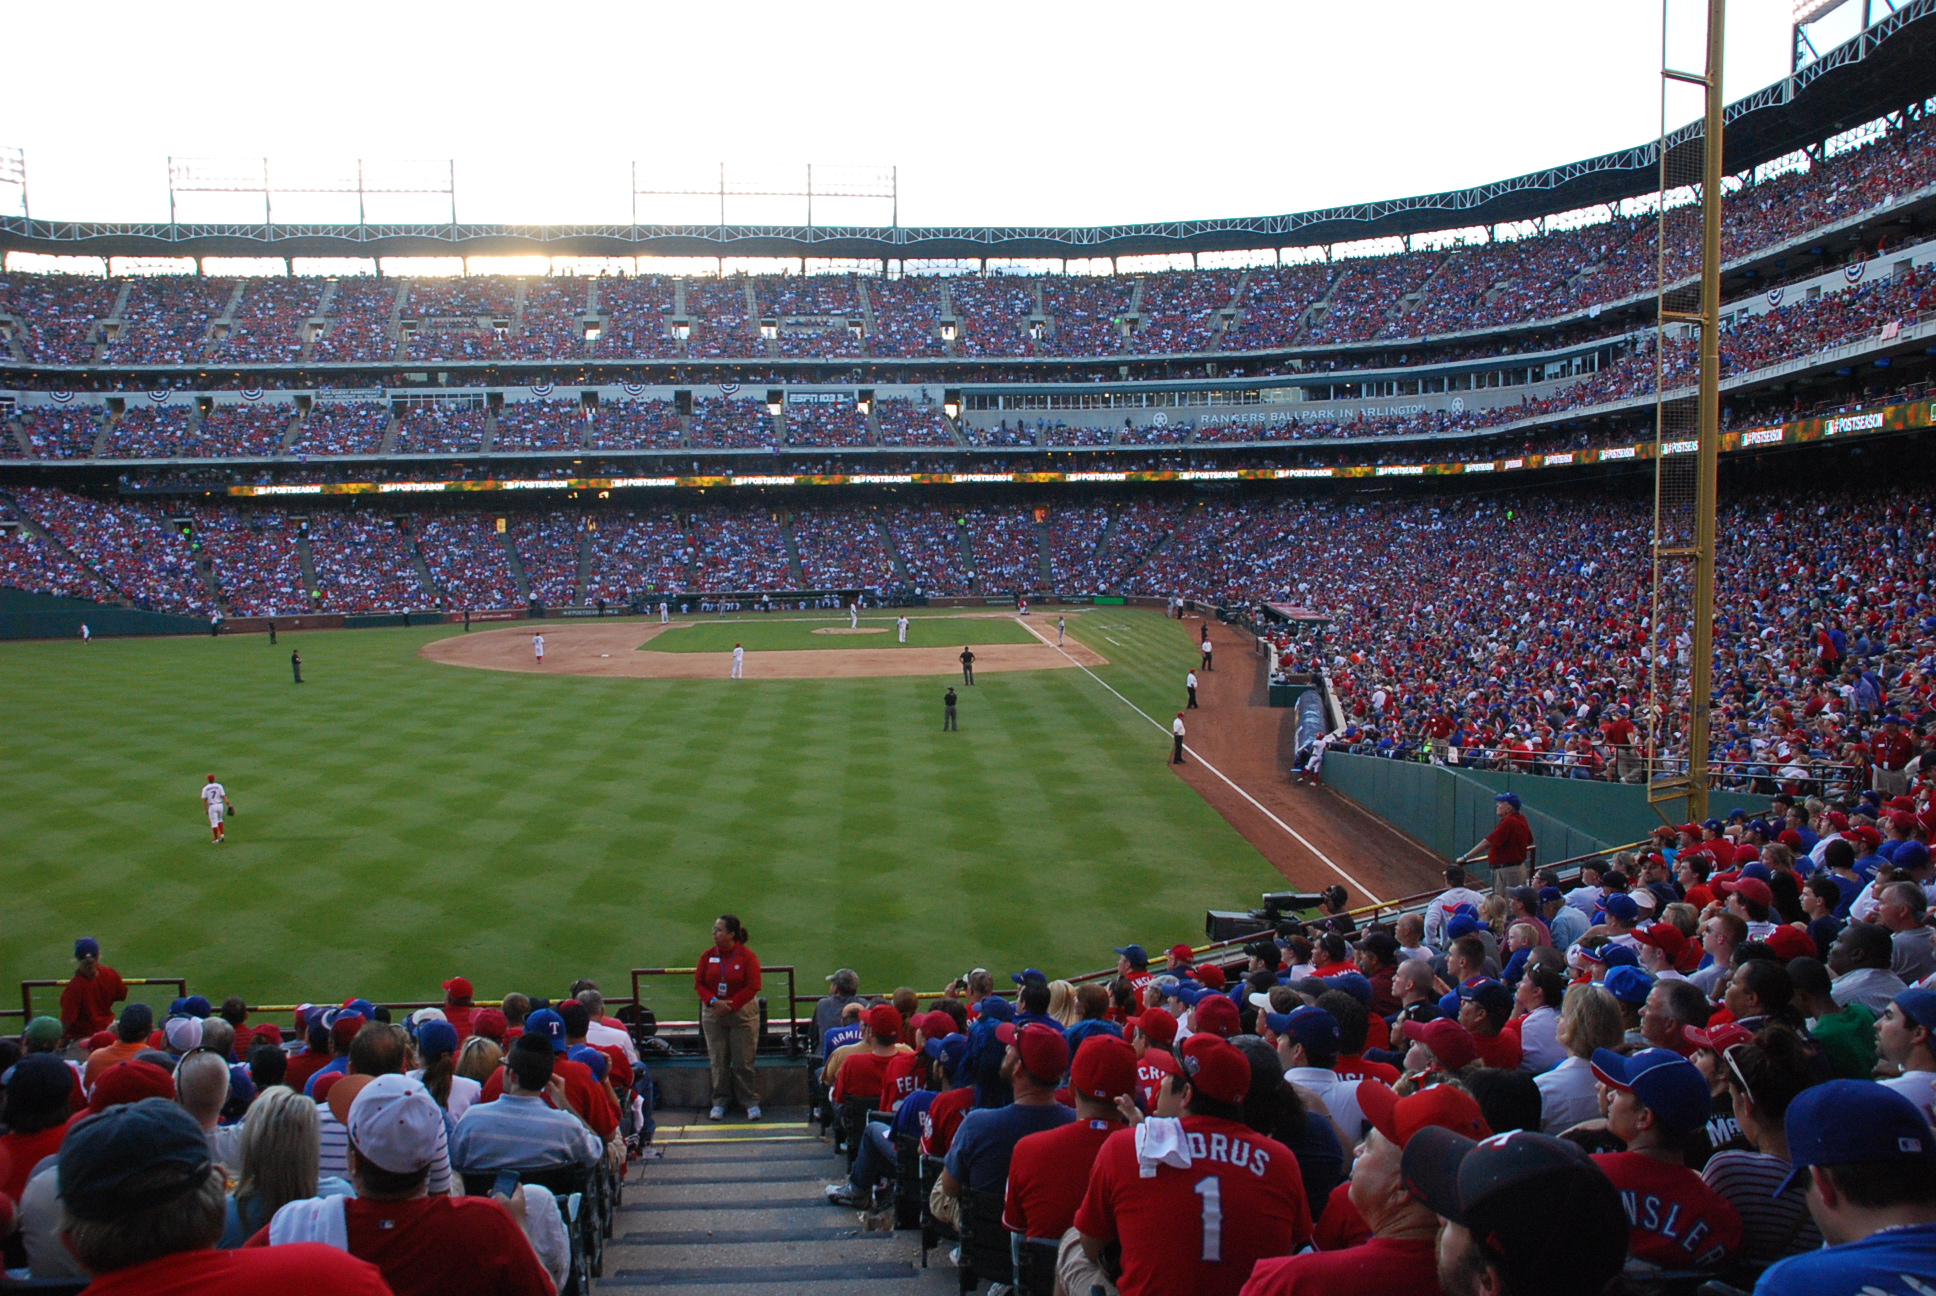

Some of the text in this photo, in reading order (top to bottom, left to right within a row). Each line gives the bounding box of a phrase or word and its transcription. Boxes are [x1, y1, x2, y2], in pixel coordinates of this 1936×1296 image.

[789, 393, 818, 403] ESPN
[1200, 412, 1266, 423] RANGERS
[1340, 408, 1353, 417] IN
[1360, 404, 1427, 416] ARLINGTON
[1834, 412, 1884, 433] #POSTSEASON
[1667, 440, 1699, 454] #POSTSEAS
[1190, 471, 1238, 479] #POSTSEASON
[1284, 469, 1332, 477] #POSTSEASON
[1384, 466, 1423, 475] #POSTSEASON
[742, 476, 795, 485] #POSTSEASON
[860, 475, 912, 483] #POSTSEASON
[962, 473, 1013, 482] #POSTSEASON
[1077, 472, 1126, 480] #POSTSEASON
[514, 480, 568, 489] #POSTSEASON
[622, 478, 676, 487] #POSTSEASON
[265, 485, 321, 494] #POSTSEASON
[391, 483, 445, 492] #POSTSEASON
[549, 1021, 560, 1035] T
[831, 1030, 863, 1046] HAMIL
[1137, 1065, 1166, 1081] CR
[896, 1076, 927, 1093] FEL
[1186, 1132, 1271, 1177] DRUS
[1193, 1174, 1223, 1262] 1
